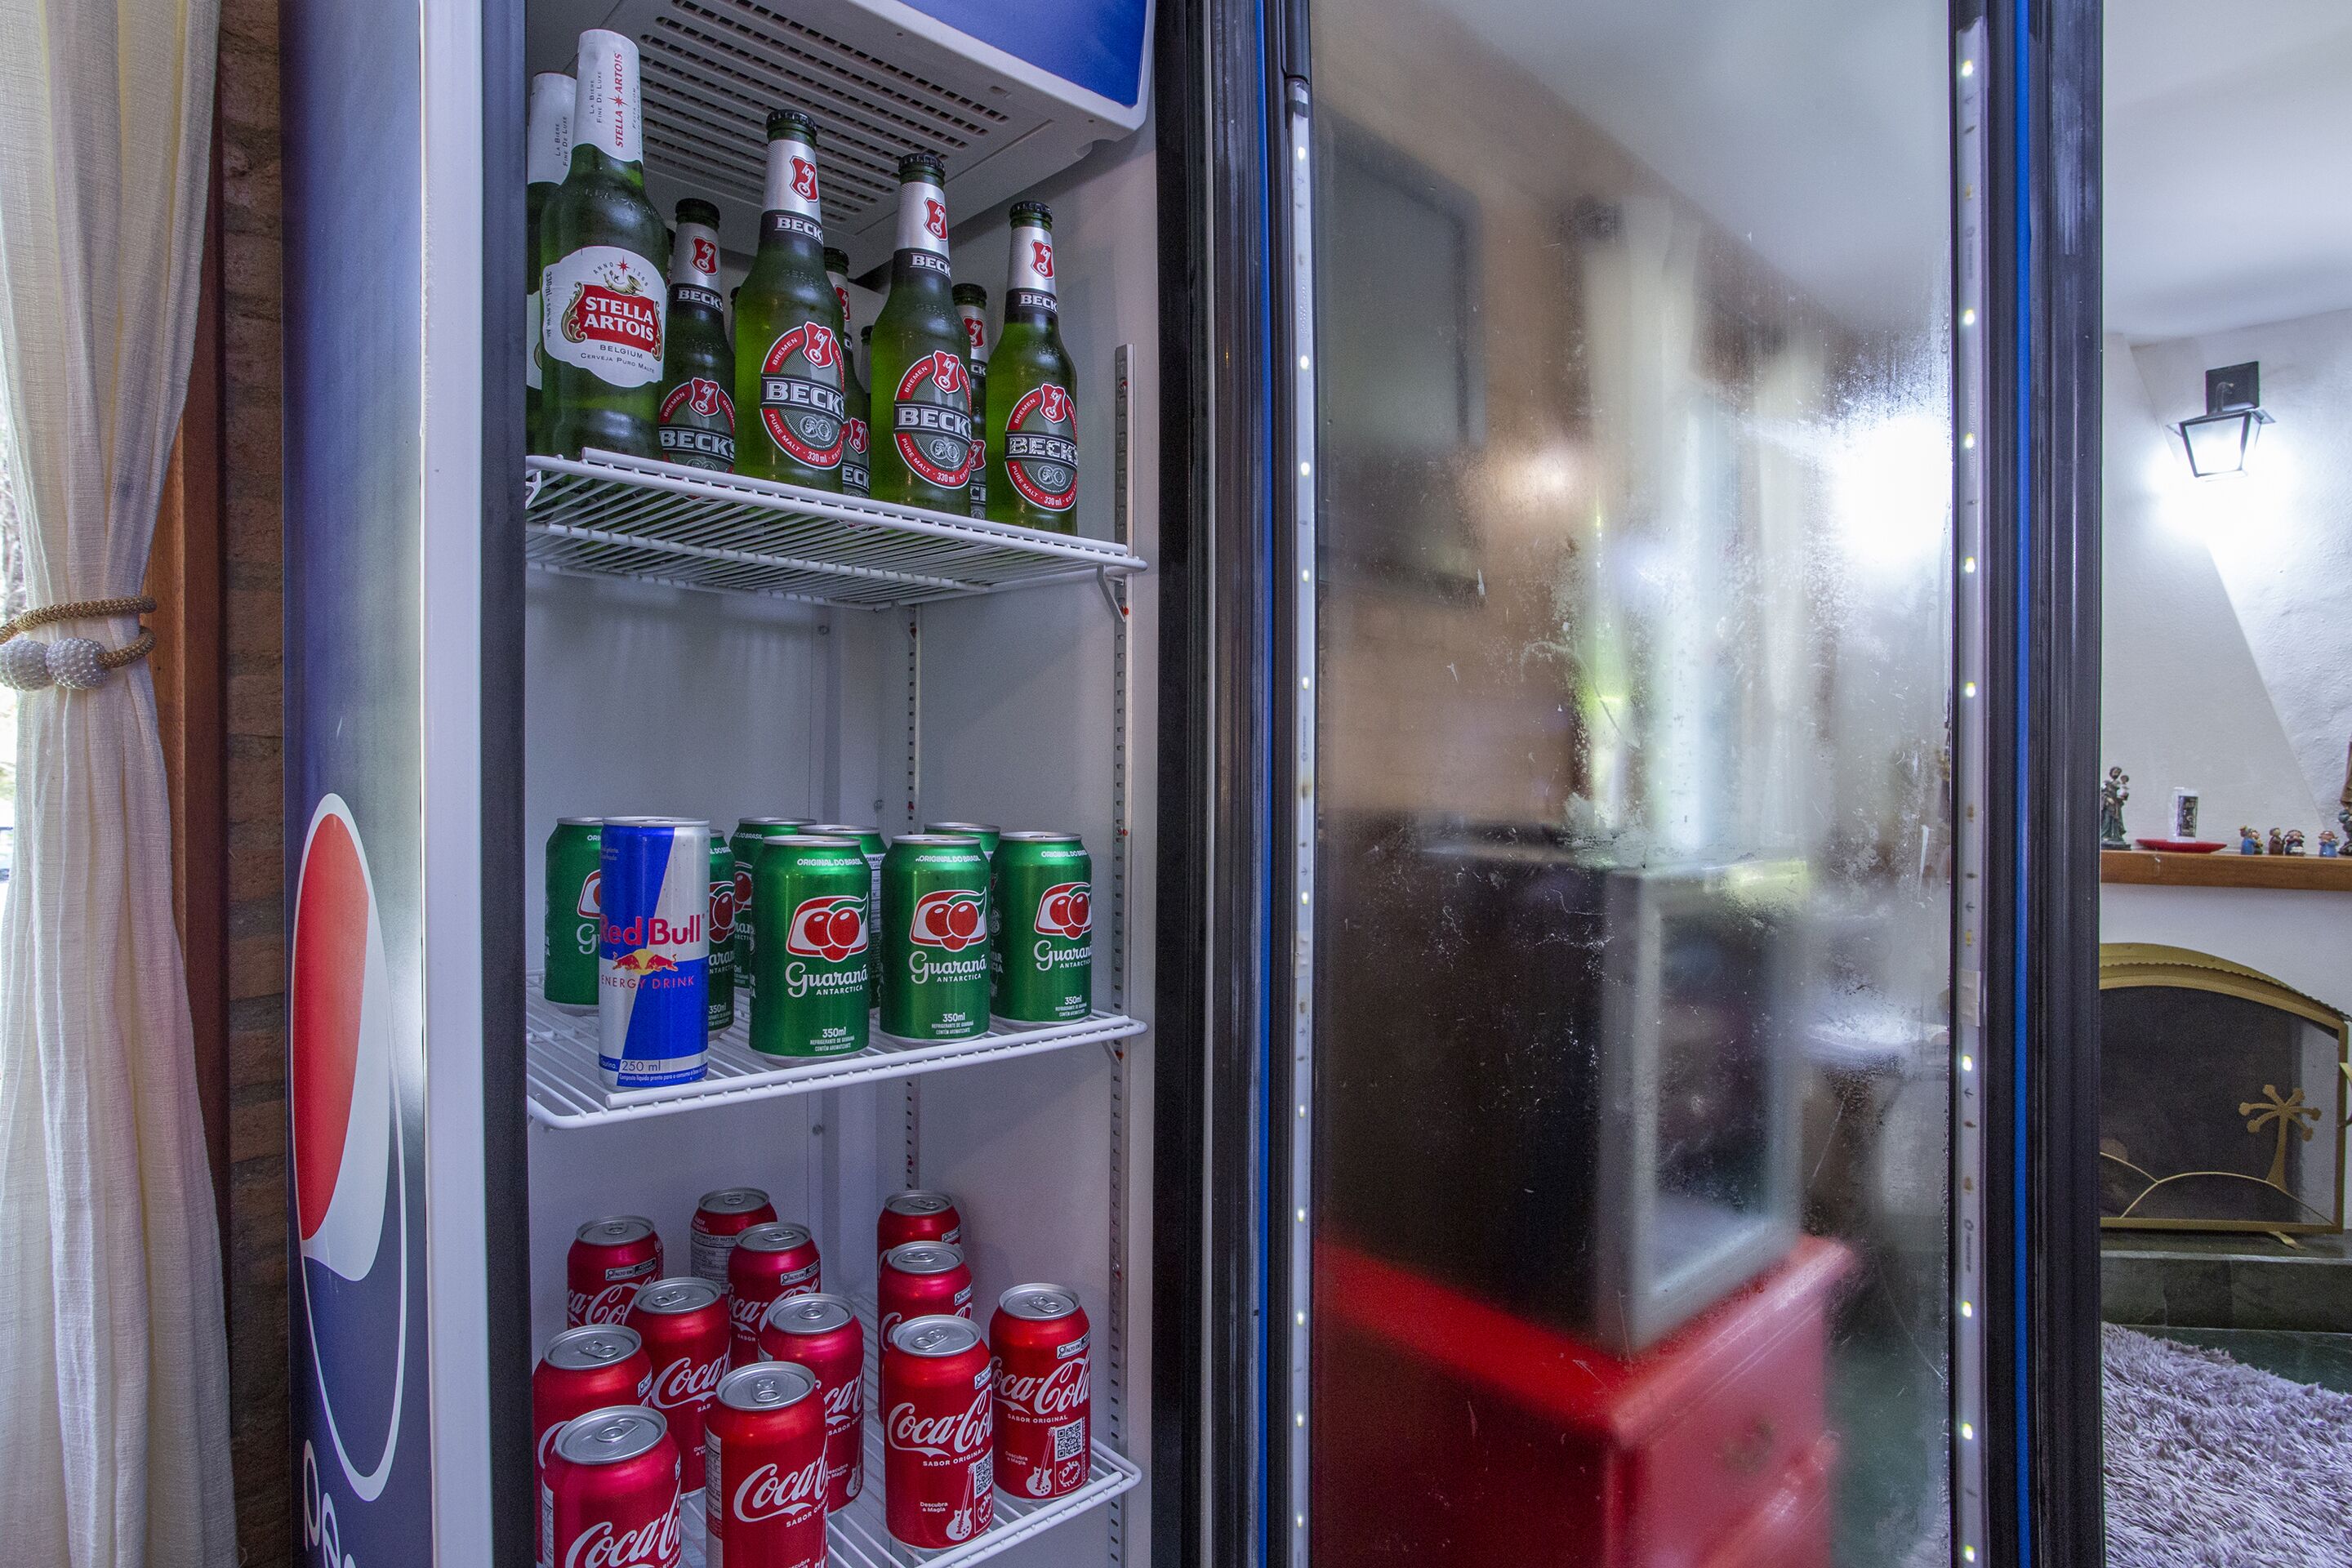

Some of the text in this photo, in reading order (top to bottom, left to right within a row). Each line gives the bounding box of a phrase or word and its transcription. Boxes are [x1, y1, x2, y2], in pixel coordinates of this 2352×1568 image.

[613, 52, 624, 148] STELLA ARTOIS
[777, 216, 823, 243] BECK
[593, 261, 614, 275] ANNO
[912, 254, 951, 278] BECK
[585, 296, 654, 326] STELLA
[1020, 293, 1058, 314] BECK
[584, 314, 654, 342] ARTOIS
[599, 344, 644, 359] BELGIUM
[773, 337, 798, 367] BREMEN
[904, 365, 928, 394] BREMEN
[663, 392, 686, 417] BREMEN
[1014, 398, 1036, 424] BREMEN
[768, 413, 782, 434] PURE
[782, 434, 801, 452] MALT
[902, 438, 914, 458] PURE
[913, 457, 930, 474] MALT
[1012, 465, 1022, 484] PURE
[1022, 483, 1039, 497] MALT
[797, 858, 834, 866] ORIGINAL
[599, 913, 643, 946] Red
[648, 914, 701, 946] Bull
[909, 951, 987, 984] Guaraná
[1033, 940, 1092, 971] Guaran
[1059, 959, 1091, 969] ANTARCTIC
[601, 974, 694, 990] ENERGY DRINK
[786, 961, 868, 998] Guaraná
[936, 973, 982, 983] ANTARCTICA
[816, 985, 863, 996] ANTARCTICA
[1064, 995, 1082, 1005] 350ml
[942, 1012, 966, 1022] 350ml
[822, 1027, 846, 1038] 350ml
[621, 1060, 644, 1071] 250
[648, 1060, 661, 1071] ml
[697, 1403, 711, 1412] SAB
[1008, 1414, 1068, 1424] SABOR ORIGINAL
[888, 1383, 993, 1458] Coca-Col
[953, 1448, 984, 1464] ORIGINAL
[786, 1510, 812, 1527] SABOR
